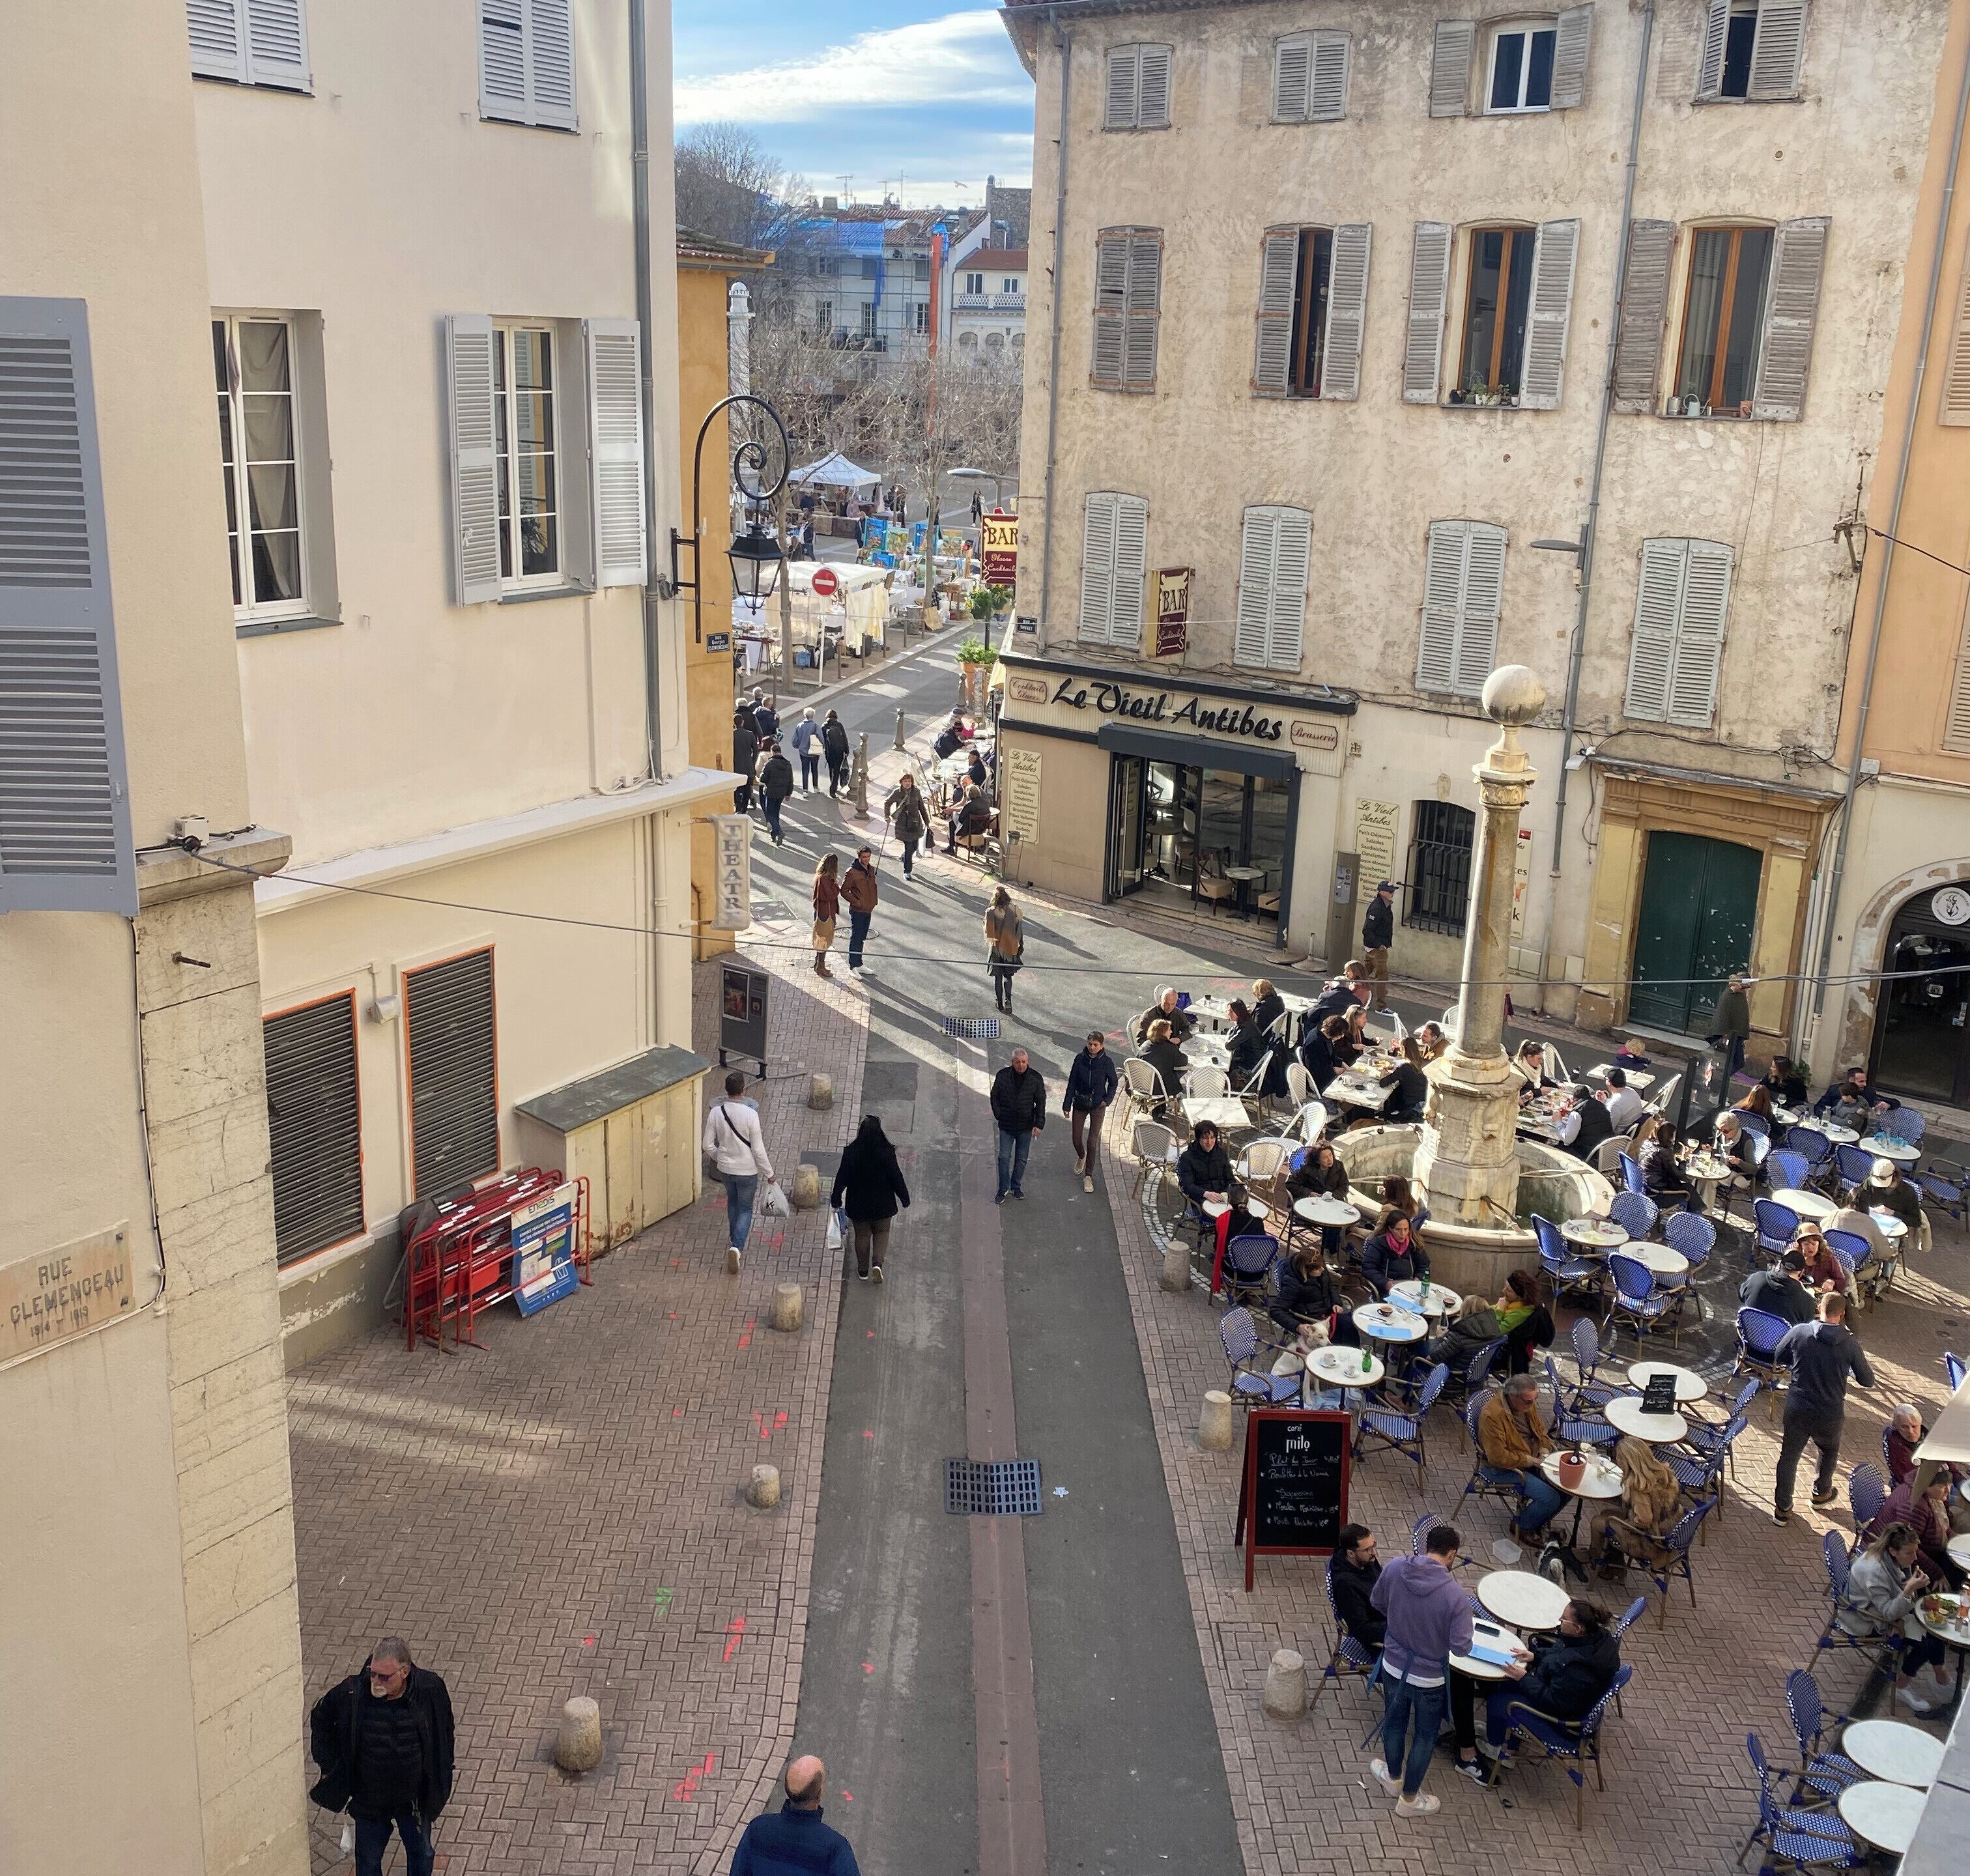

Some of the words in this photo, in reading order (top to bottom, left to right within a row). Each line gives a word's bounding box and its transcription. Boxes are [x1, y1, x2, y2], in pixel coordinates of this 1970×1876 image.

[987, 527, 1018, 545] BAR
[1163, 588, 1186, 612] BAR
[1012, 679, 1044, 692] Cocktails
[1017, 690, 1039, 700] Glaces
[1050, 677, 1087, 709] Le
[1090, 682, 1166, 722] Vieil
[1171, 696, 1283, 741] Antibes
[1291, 726, 1337, 742] Brasserie
[1010, 750, 1021, 760] Le
[1023, 752, 1041, 763] Vieil
[1012, 762, 1036, 773] Antibes
[1358, 800, 1370, 811] Le
[1374, 803, 1399, 816] Vieil
[1360, 814, 1392, 826] Antibes
[1361, 844, 1388, 854] Sandwiches
[1365, 838, 1384, 846] Salades
[722, 825, 743, 912] THEATR
[38, 1256, 72, 1287] RUE
[10, 1264, 124, 1324] CLEMENCEAU
[1287, 1423, 1303, 1432] café
[1286, 1434, 1310, 1453] milo
